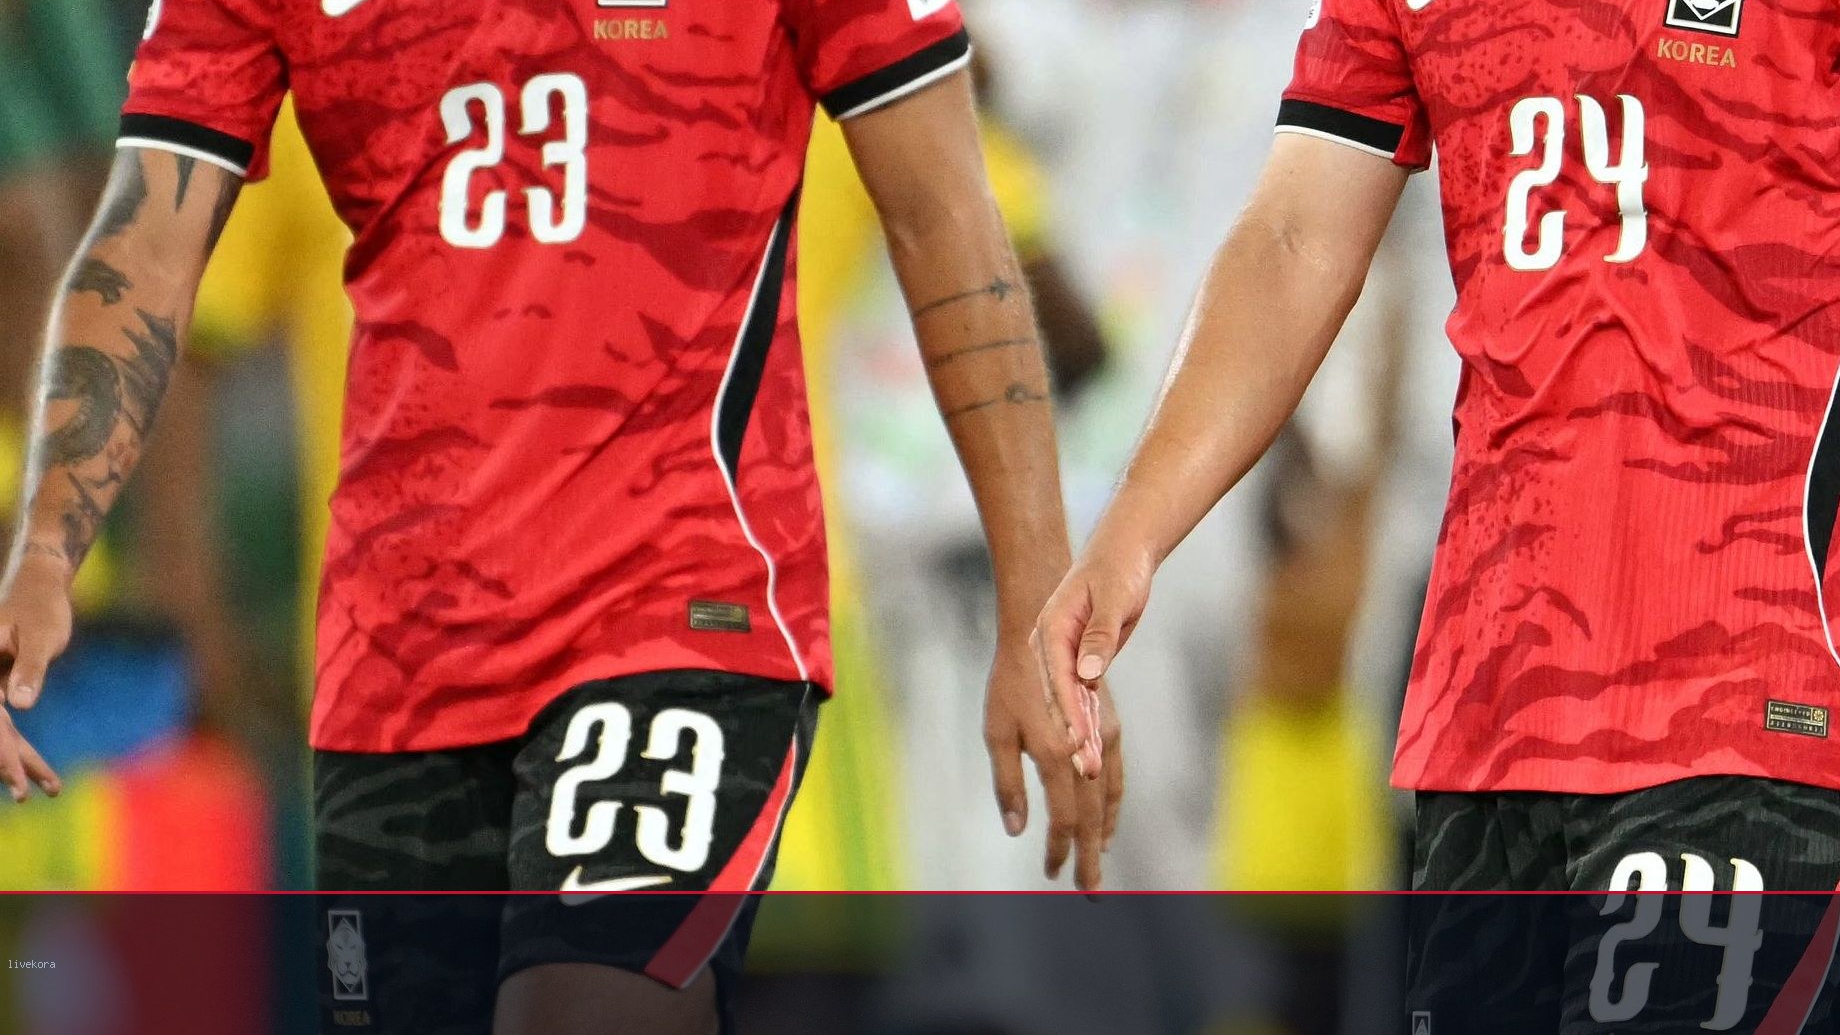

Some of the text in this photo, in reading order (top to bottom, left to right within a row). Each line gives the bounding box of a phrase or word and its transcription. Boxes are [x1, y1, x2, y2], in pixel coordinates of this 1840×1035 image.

[593, 19, 669, 40] KOREA
[1657, 38, 1736, 68] KOREA
[438, 72, 589, 249] 23
[1503, 94, 1649, 271] 24
[545, 702, 725, 872] 23
[1588, 851, 1764, 1031] 24
